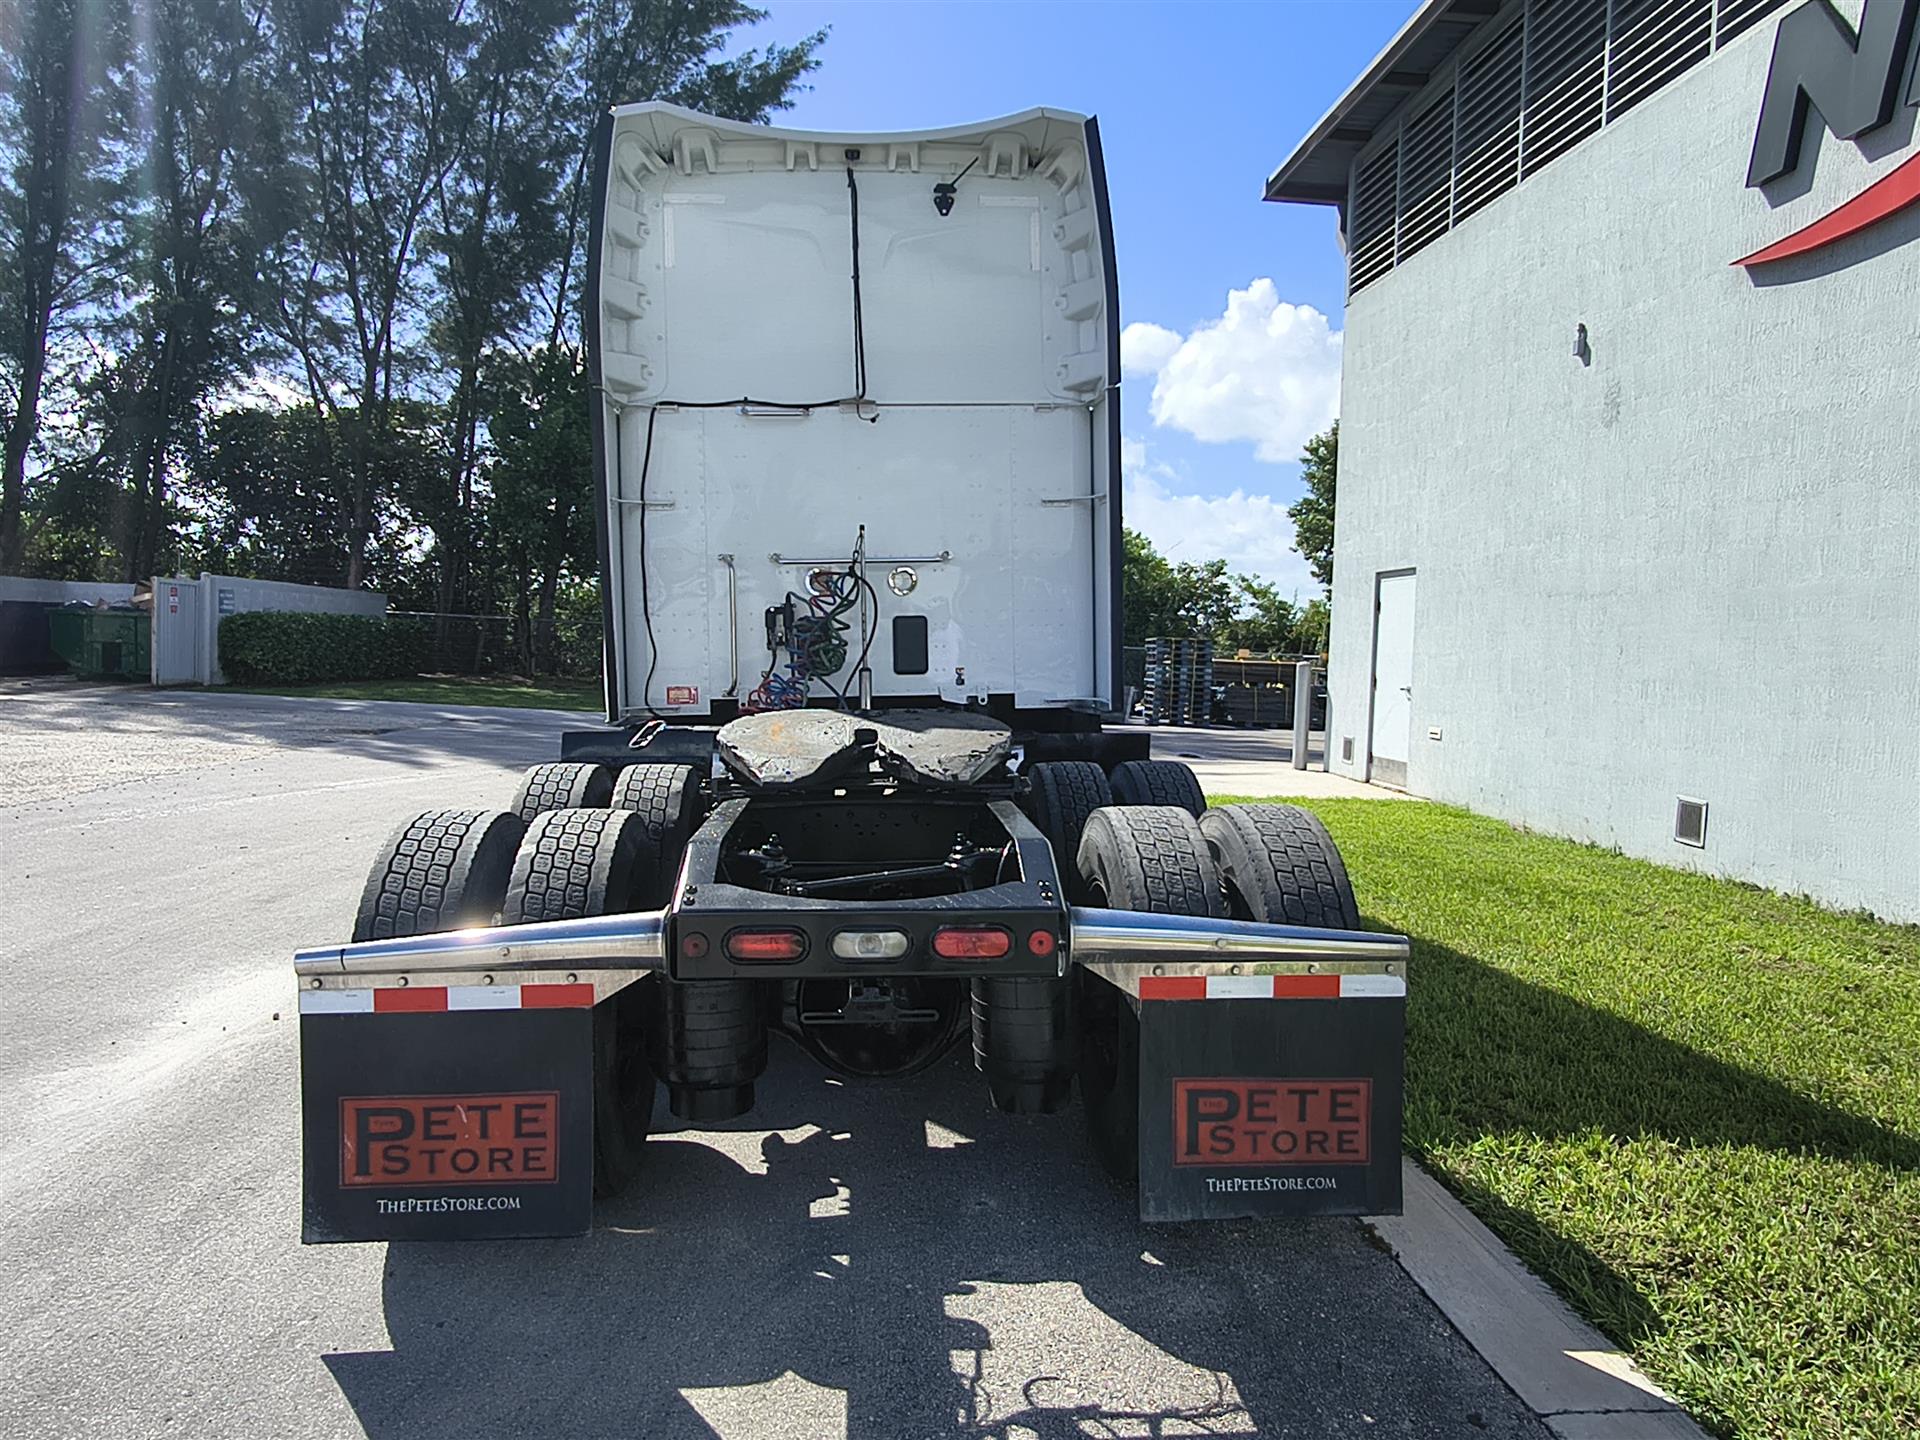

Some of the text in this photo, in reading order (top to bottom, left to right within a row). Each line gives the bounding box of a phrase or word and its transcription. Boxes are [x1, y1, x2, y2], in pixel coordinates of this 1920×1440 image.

[354, 1104, 547, 1176] PETE
[1185, 1088, 1360, 1155] PETE
[1210, 1125, 1359, 1155] STORE
[382, 1145, 547, 1175] STORE
